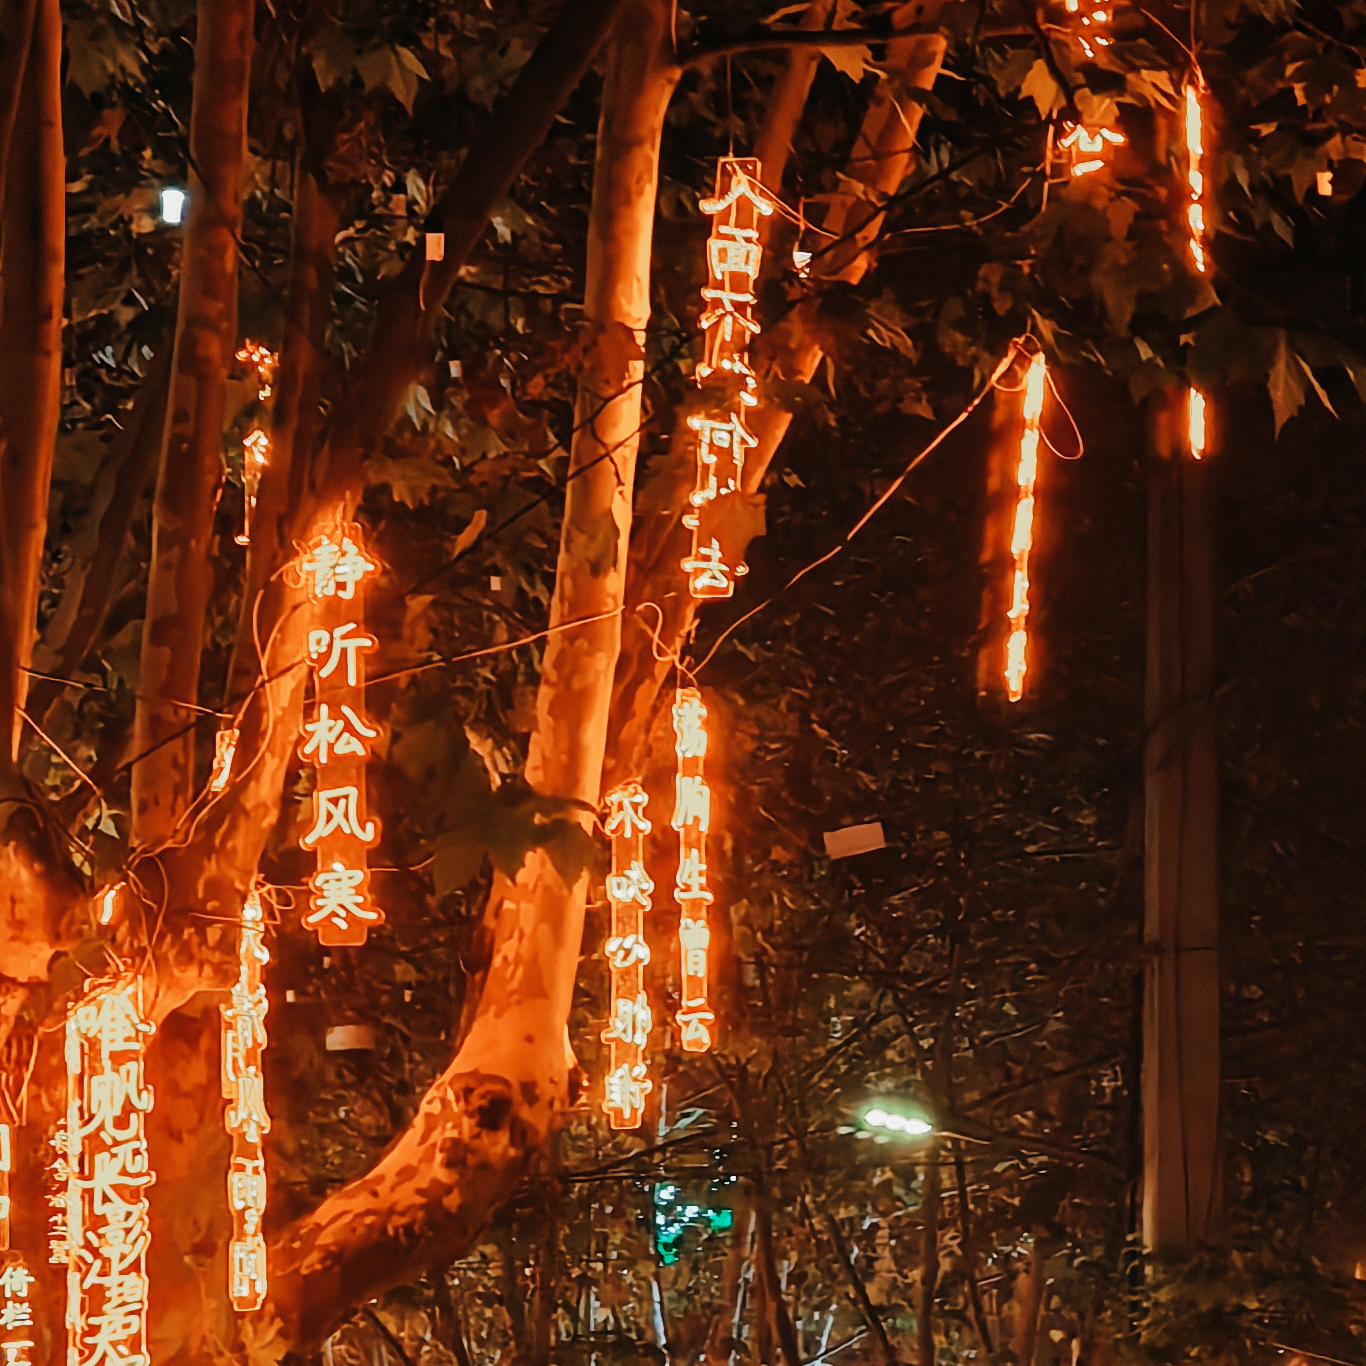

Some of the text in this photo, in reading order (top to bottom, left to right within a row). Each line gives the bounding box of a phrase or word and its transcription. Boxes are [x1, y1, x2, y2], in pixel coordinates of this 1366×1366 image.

[302, 537, 377, 930] 静听松风寒
